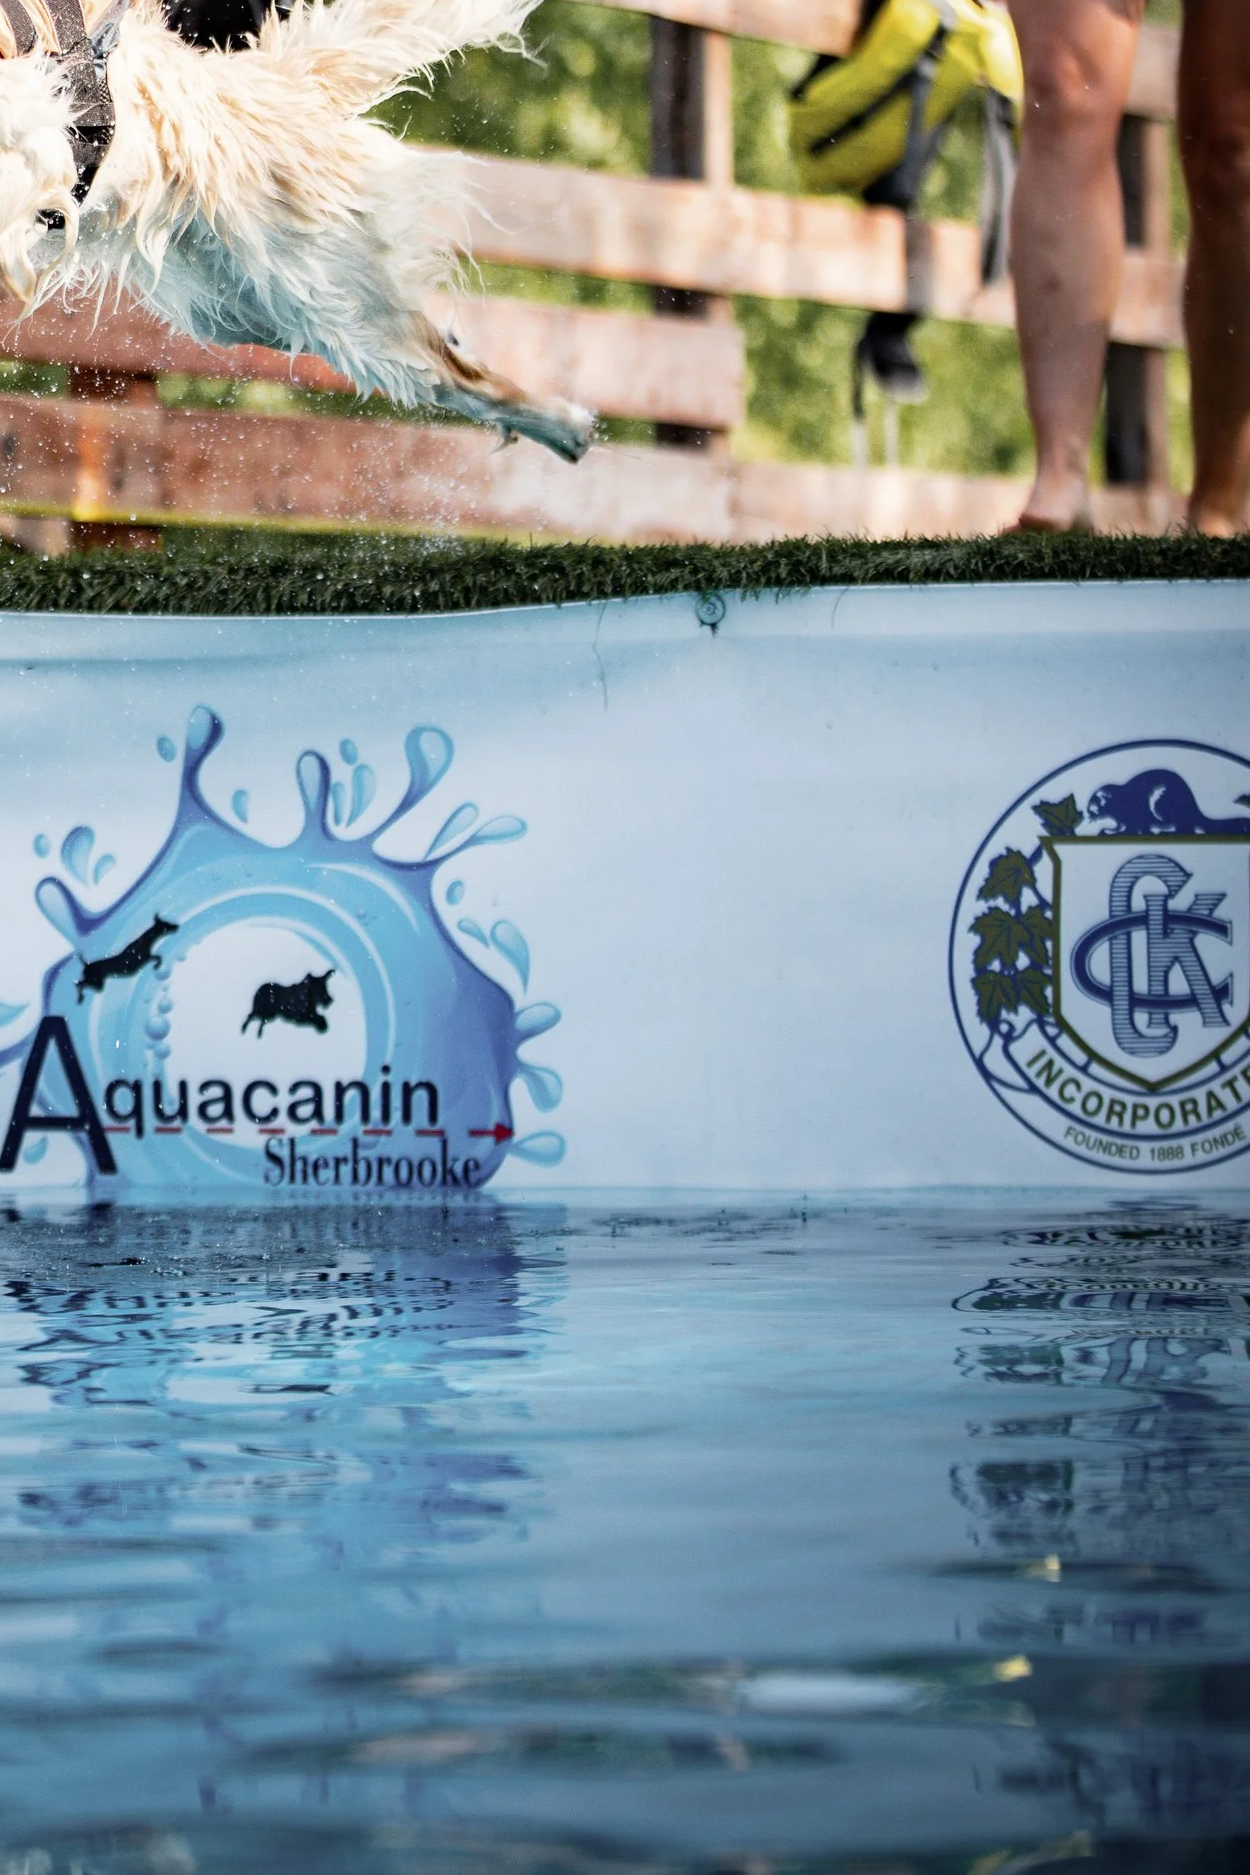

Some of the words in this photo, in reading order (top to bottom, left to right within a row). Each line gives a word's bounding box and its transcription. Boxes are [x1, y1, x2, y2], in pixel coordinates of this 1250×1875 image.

[262, 1136, 482, 1189] Sherbrooke
[1063, 1125, 1141, 1161] FOUNDED
[1150, 1145, 1185, 1162] 1888
[1190, 1122, 1248, 1158] FONDÉ
